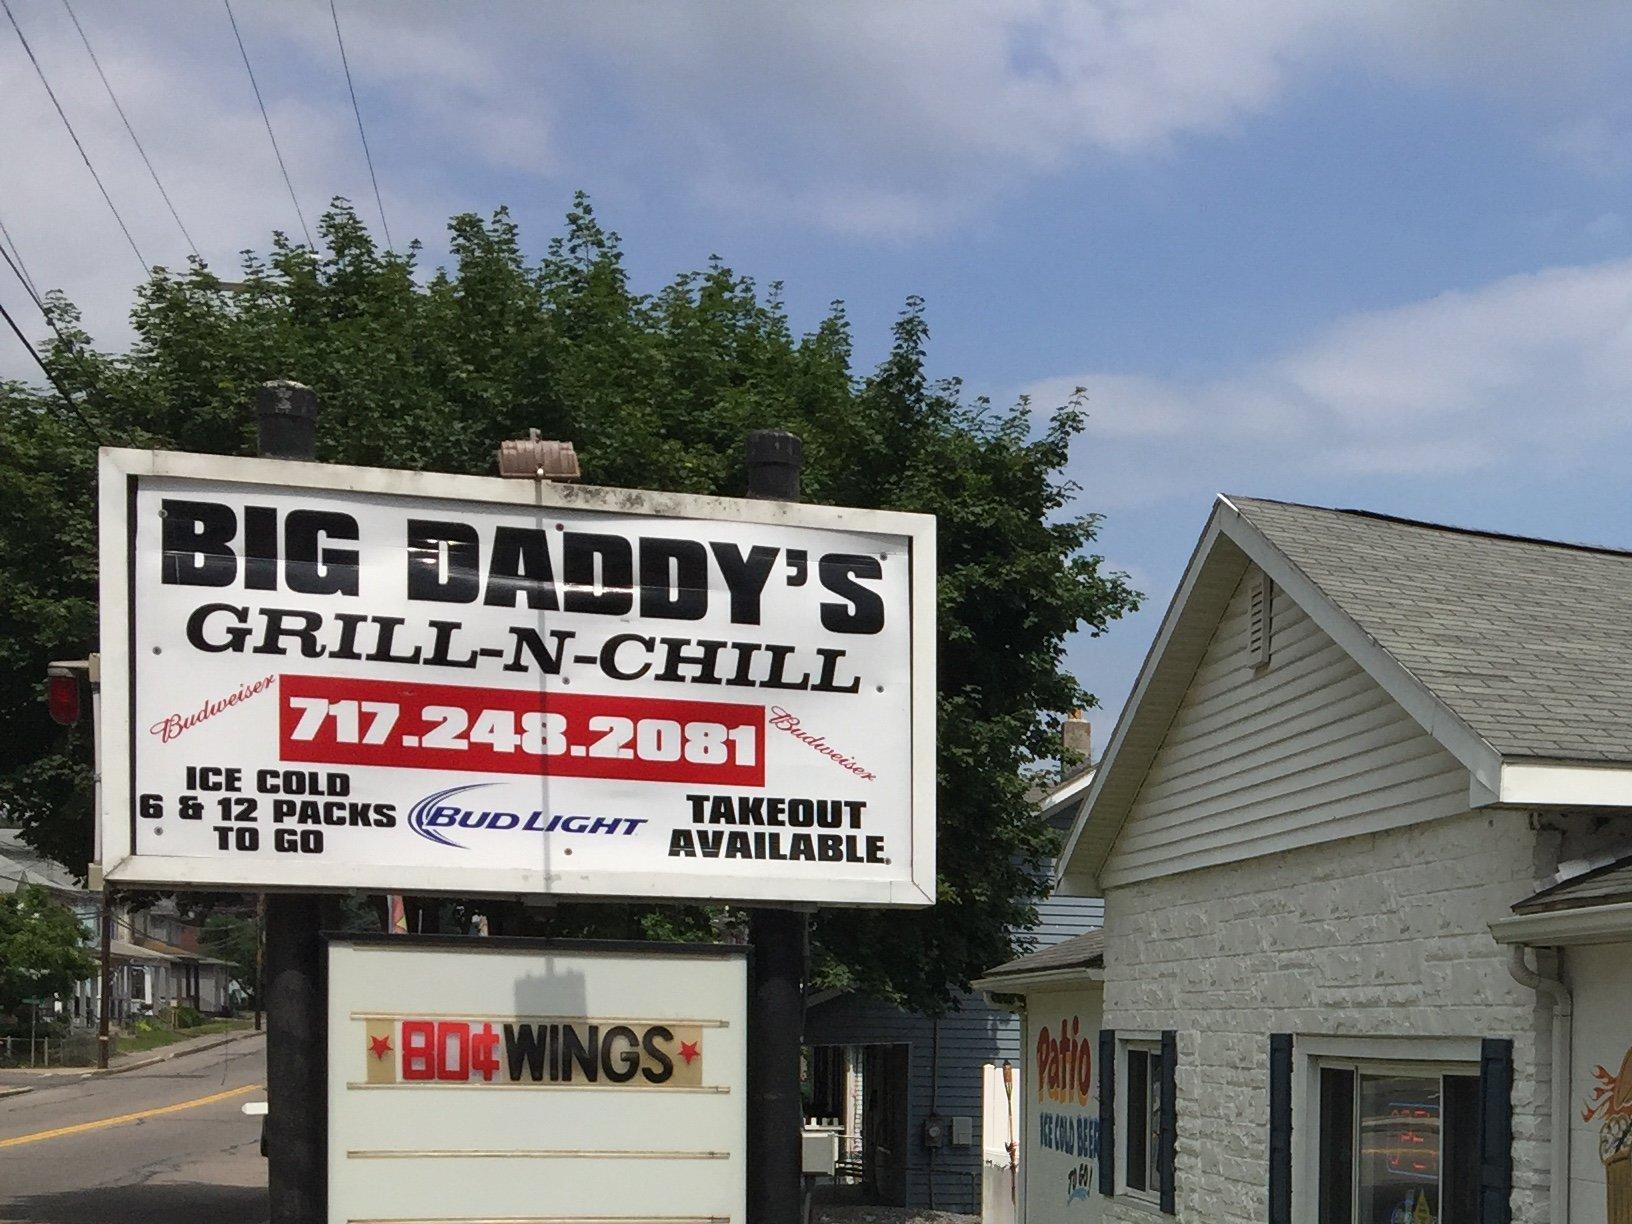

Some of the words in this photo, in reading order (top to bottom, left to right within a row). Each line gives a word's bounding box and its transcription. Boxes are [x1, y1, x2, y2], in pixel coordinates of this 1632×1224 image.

[161, 498, 359, 597] BIG
[407, 518, 885, 635] DADDY'S
[186, 602, 861, 694] GRILL-N-CHILL
[150, 674, 277, 743] Budweiser
[289, 697, 756, 772] 717.248.2081
[770, 705, 877, 782] Budweiser
[186, 766, 242, 792] ICE
[256, 769, 350, 797] COLD
[139, 793, 164, 819] 6
[178, 795, 204, 820] &
[217, 797, 258, 822] 12
[272, 799, 397, 828] PACKS
[428, 806, 521, 830] BUD
[524, 809, 649, 836] LIGHT
[686, 794, 866, 829] TAKEOUT
[213, 826, 260, 851] TO
[274, 828, 324, 854] GO
[668, 828, 886, 864] AVAILABLE
[503, 1023, 674, 1084] WINGS
[1037, 1015, 1091, 1098] Patio
[1040, 1112, 1053, 1149] ICE
[1055, 1113, 1075, 1156] COLD
